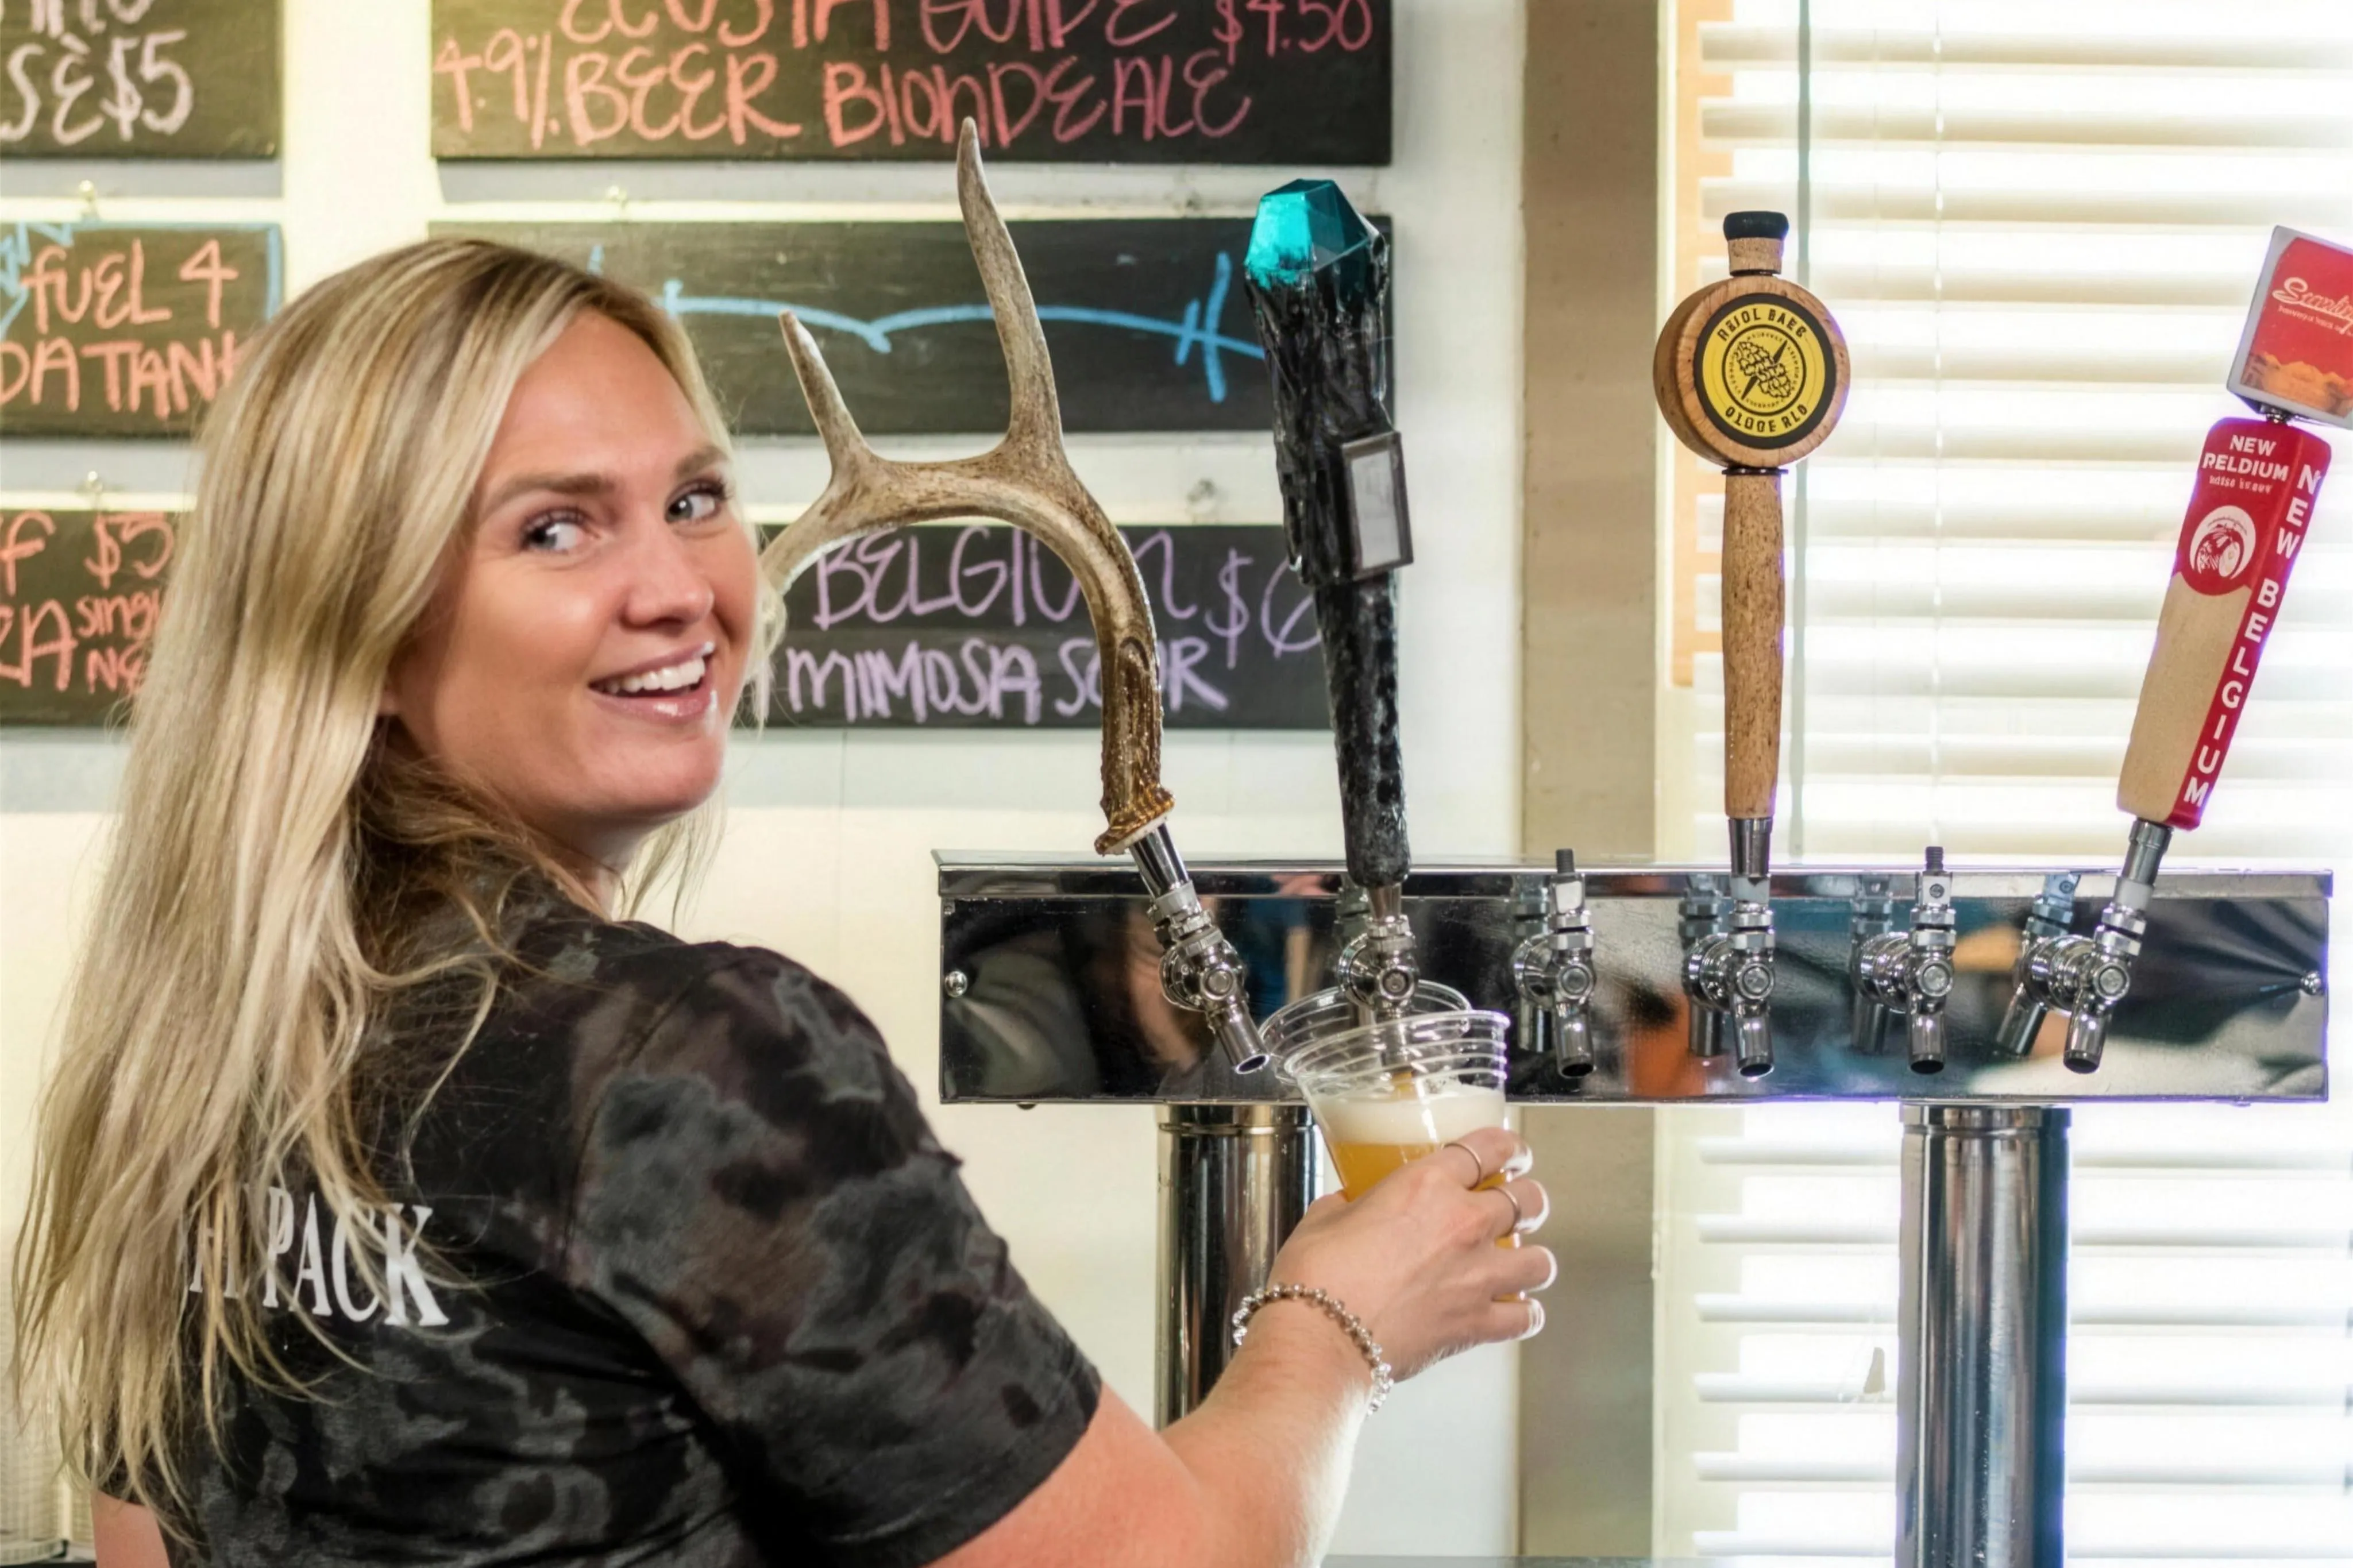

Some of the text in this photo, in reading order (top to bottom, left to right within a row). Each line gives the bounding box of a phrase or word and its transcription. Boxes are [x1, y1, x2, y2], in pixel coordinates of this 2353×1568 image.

[566, 43, 801, 146] BEER
[178, 238, 240, 330] 4
[2229, 434, 2277, 457] NEW
[2275, 464, 2321, 560] NEW
[1054, 636, 1228, 718] SR
[2184, 578, 2279, 807] BELGIUM
[263, 1185, 449, 1326] PACK
